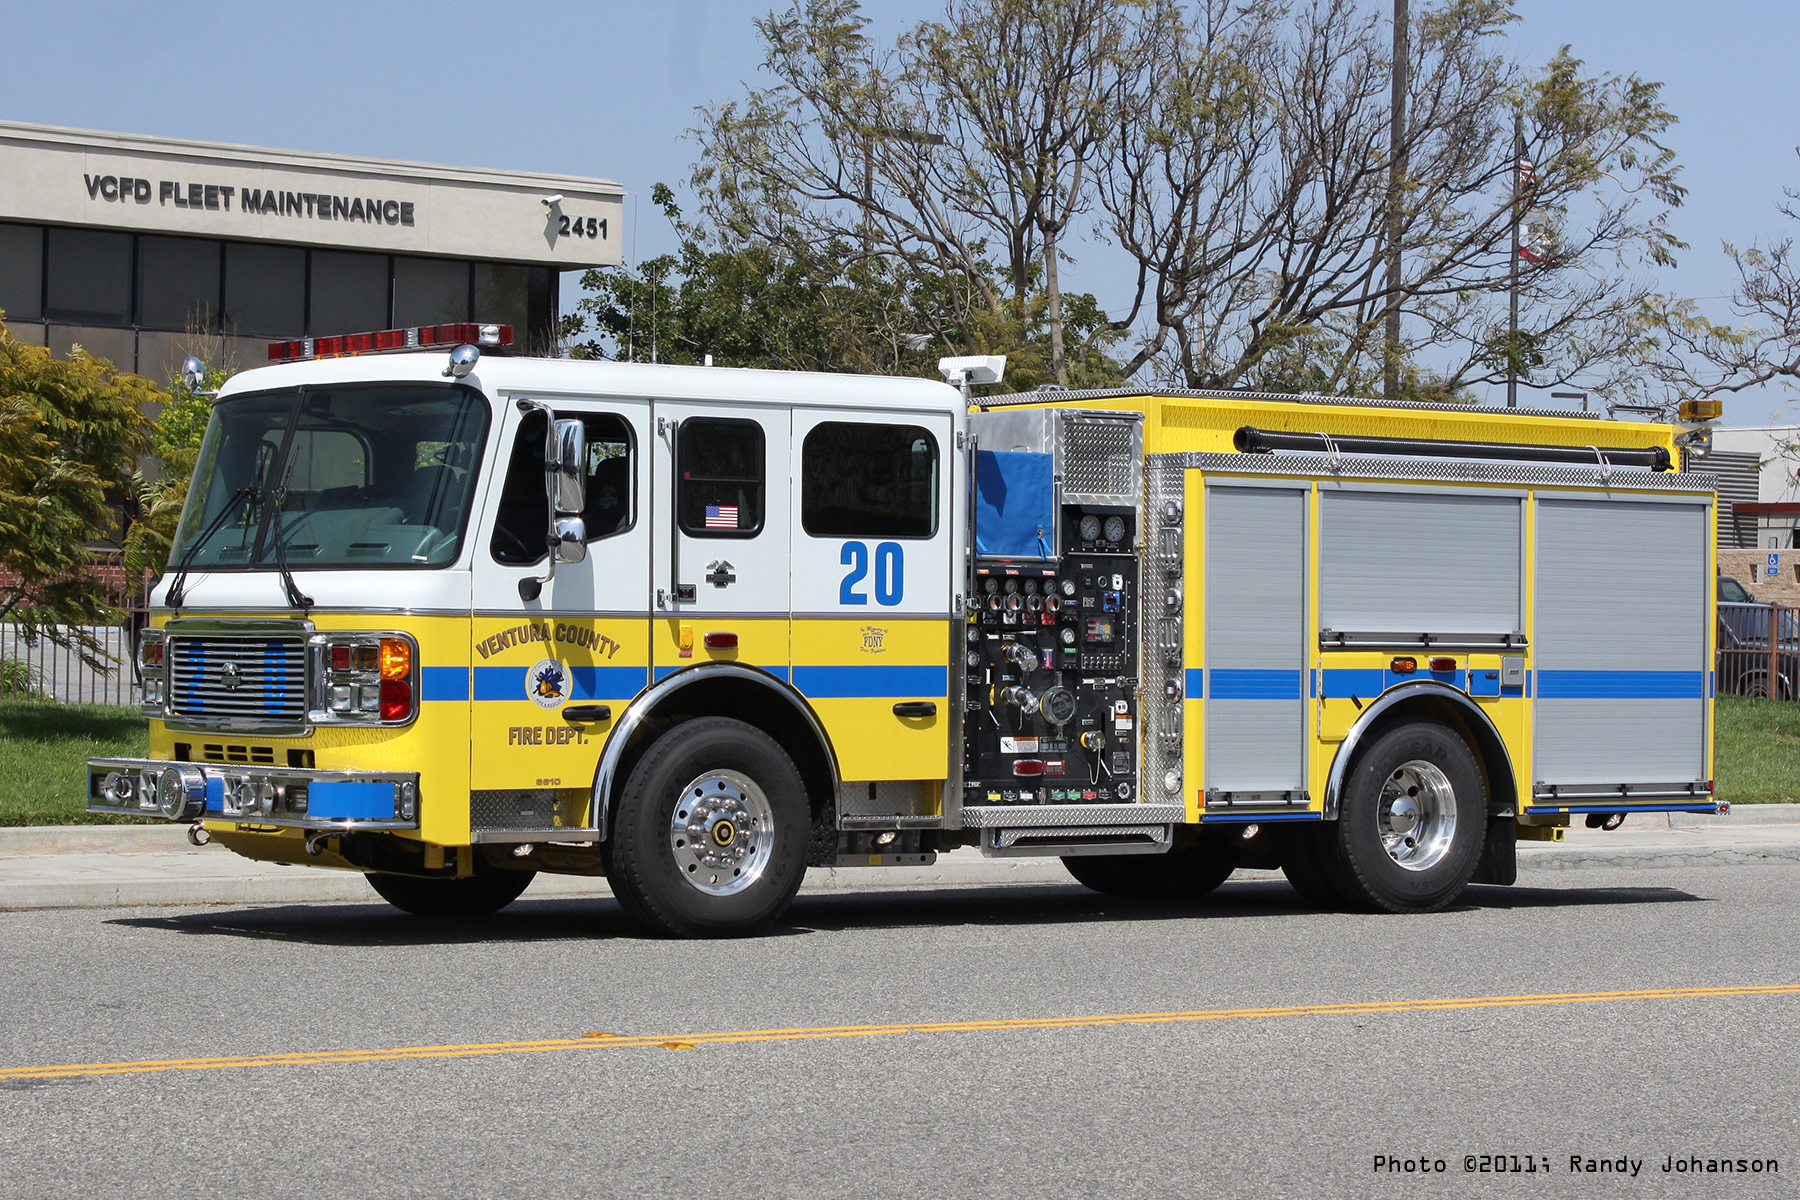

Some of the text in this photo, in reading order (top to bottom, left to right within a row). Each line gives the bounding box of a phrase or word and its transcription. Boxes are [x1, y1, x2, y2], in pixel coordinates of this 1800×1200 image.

[83, 174, 415, 224] VCFD FLEET MAINTENANCE
[558, 215, 607, 240] 2451
[839, 540, 905, 607] 20
[475, 622, 621, 660] VENTURA COUNTY
[863, 636, 883, 647] FDNY
[508, 726, 589, 746] FIRE DEPT.
